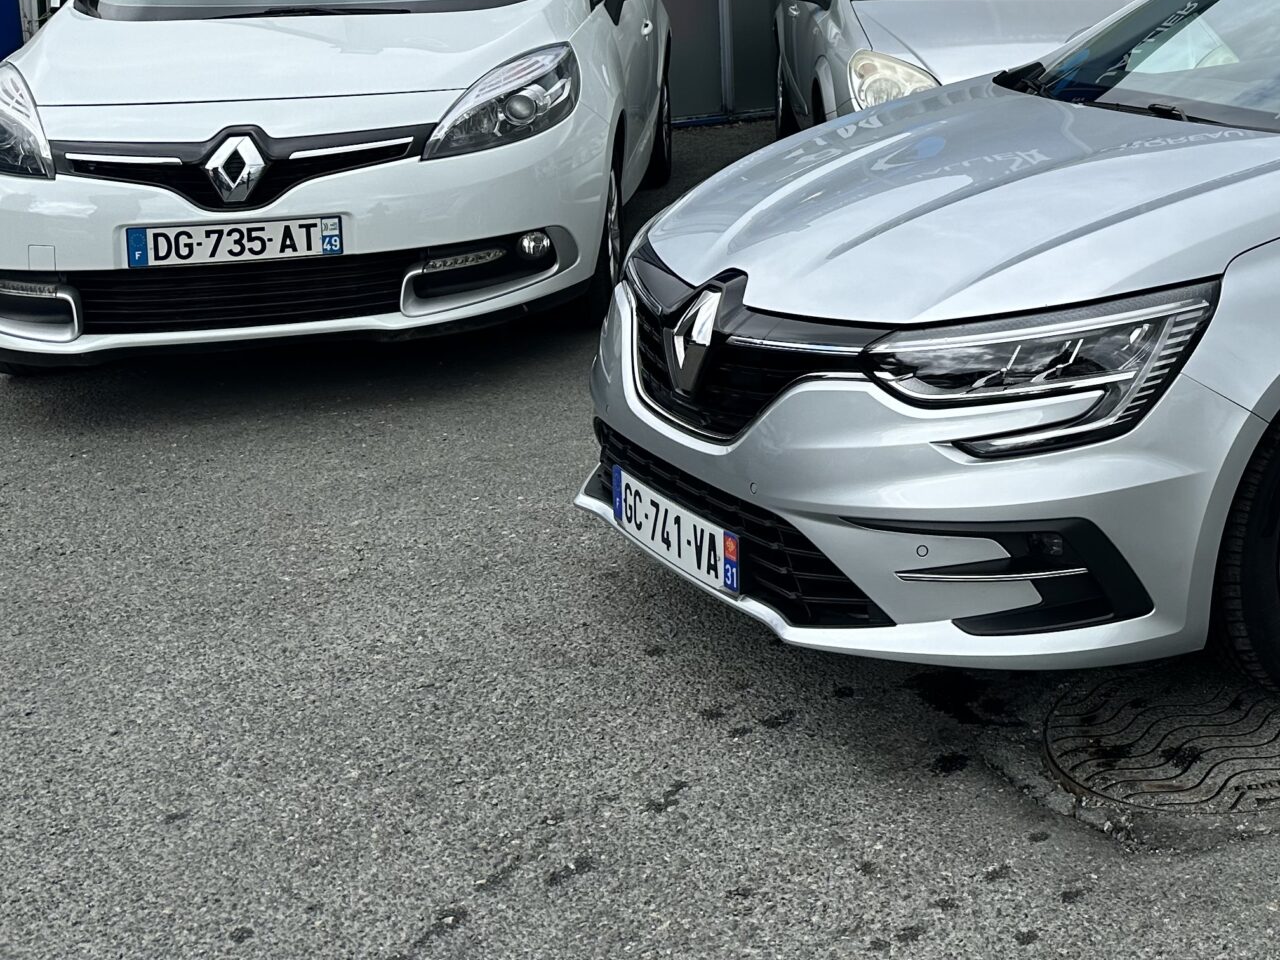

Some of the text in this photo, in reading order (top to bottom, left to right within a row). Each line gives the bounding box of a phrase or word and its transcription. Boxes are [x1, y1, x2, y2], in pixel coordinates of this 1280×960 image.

[135, 251, 142, 260] F
[152, 222, 318, 262] DG-735-AT
[323, 236, 340, 251] 49
[624, 482, 719, 580] GC-741-VA
[725, 564, 737, 588] 31
